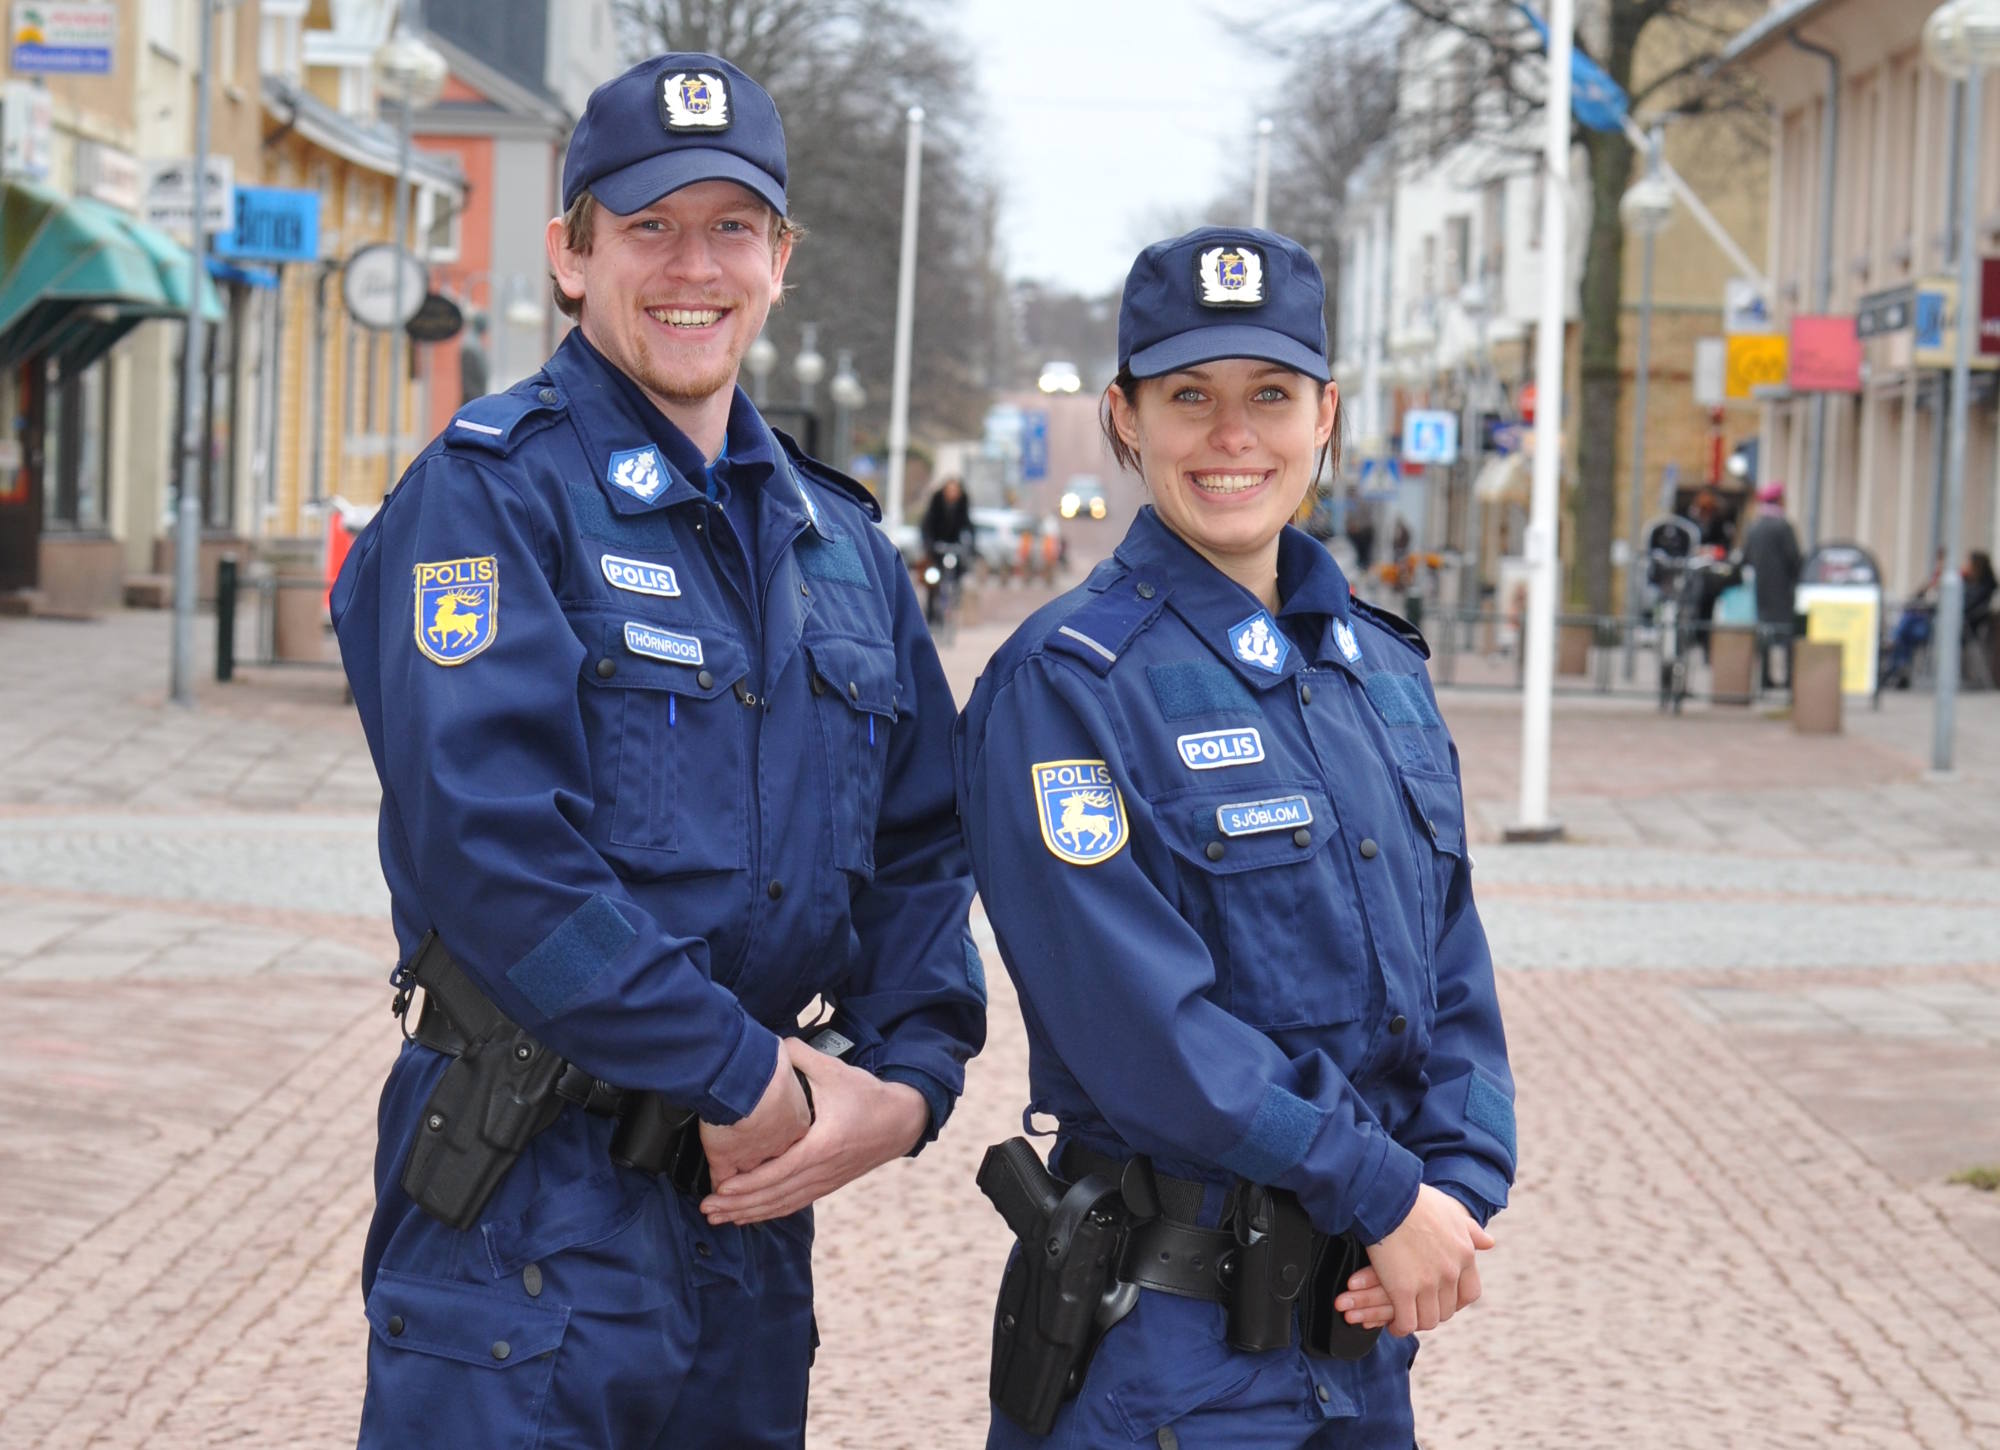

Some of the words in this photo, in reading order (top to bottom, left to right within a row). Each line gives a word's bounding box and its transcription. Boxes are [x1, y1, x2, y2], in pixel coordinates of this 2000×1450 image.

[421, 561, 493, 586] POLIS
[608, 563, 671, 591] POLIS
[628, 631, 698, 658] THÖRNROOS
[1184, 736, 1256, 762] POLIS
[1041, 766, 1112, 788] POLIS
[1231, 805, 1300, 829] SJÖBLOM
